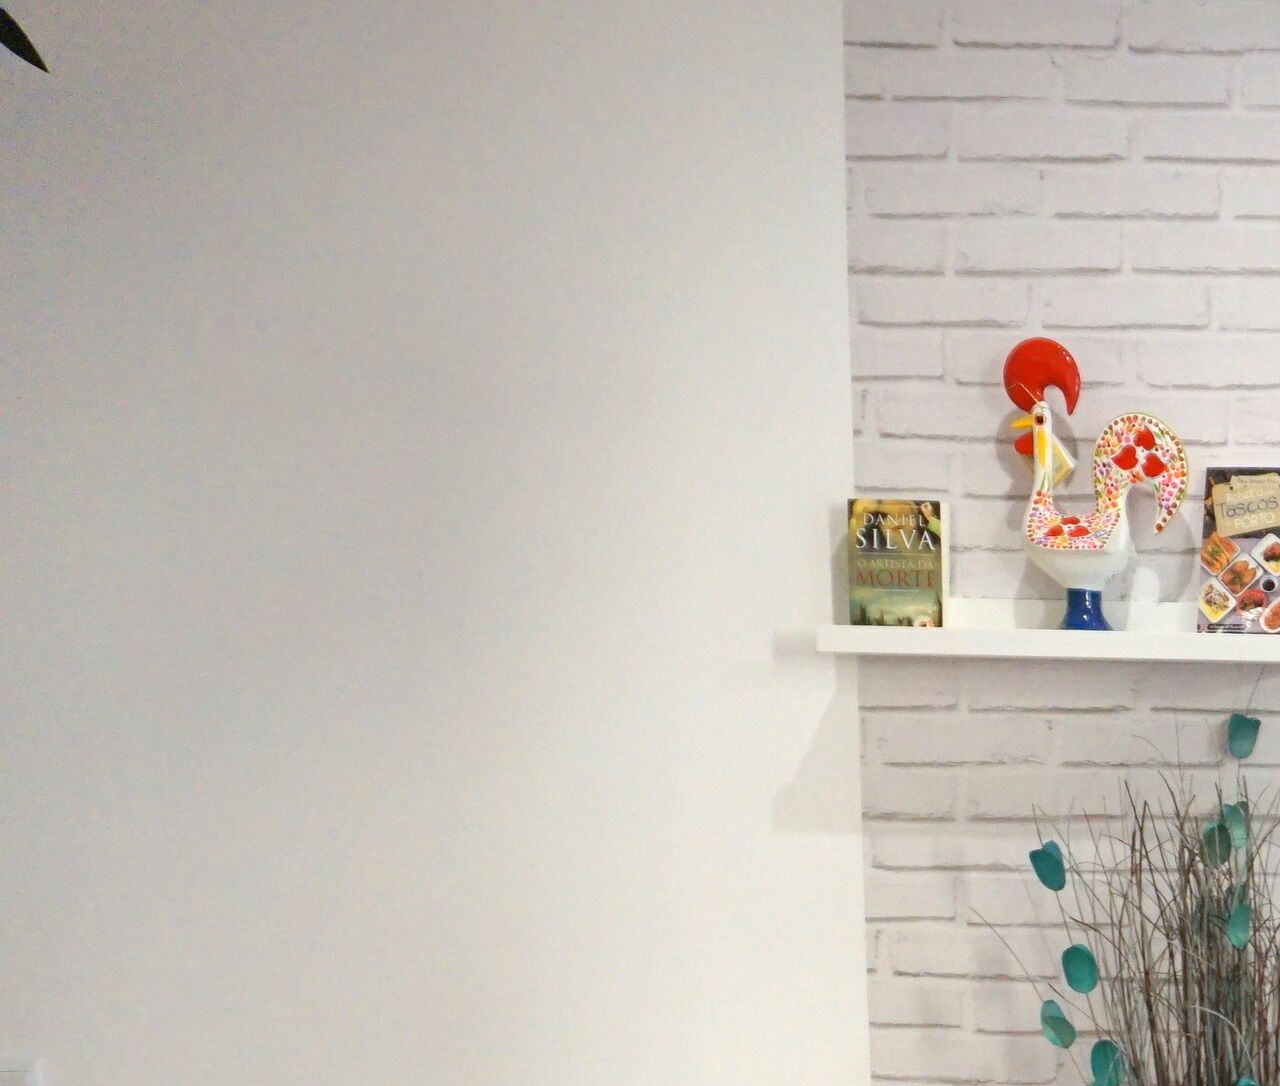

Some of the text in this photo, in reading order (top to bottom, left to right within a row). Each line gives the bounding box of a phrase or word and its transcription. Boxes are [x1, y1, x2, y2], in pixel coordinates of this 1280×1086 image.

[863, 512, 926, 526] DANIEL
[856, 527, 936, 551] SILVA
[857, 559, 935, 570] O ARTISTA DA
[857, 569, 936, 588] MORTE
